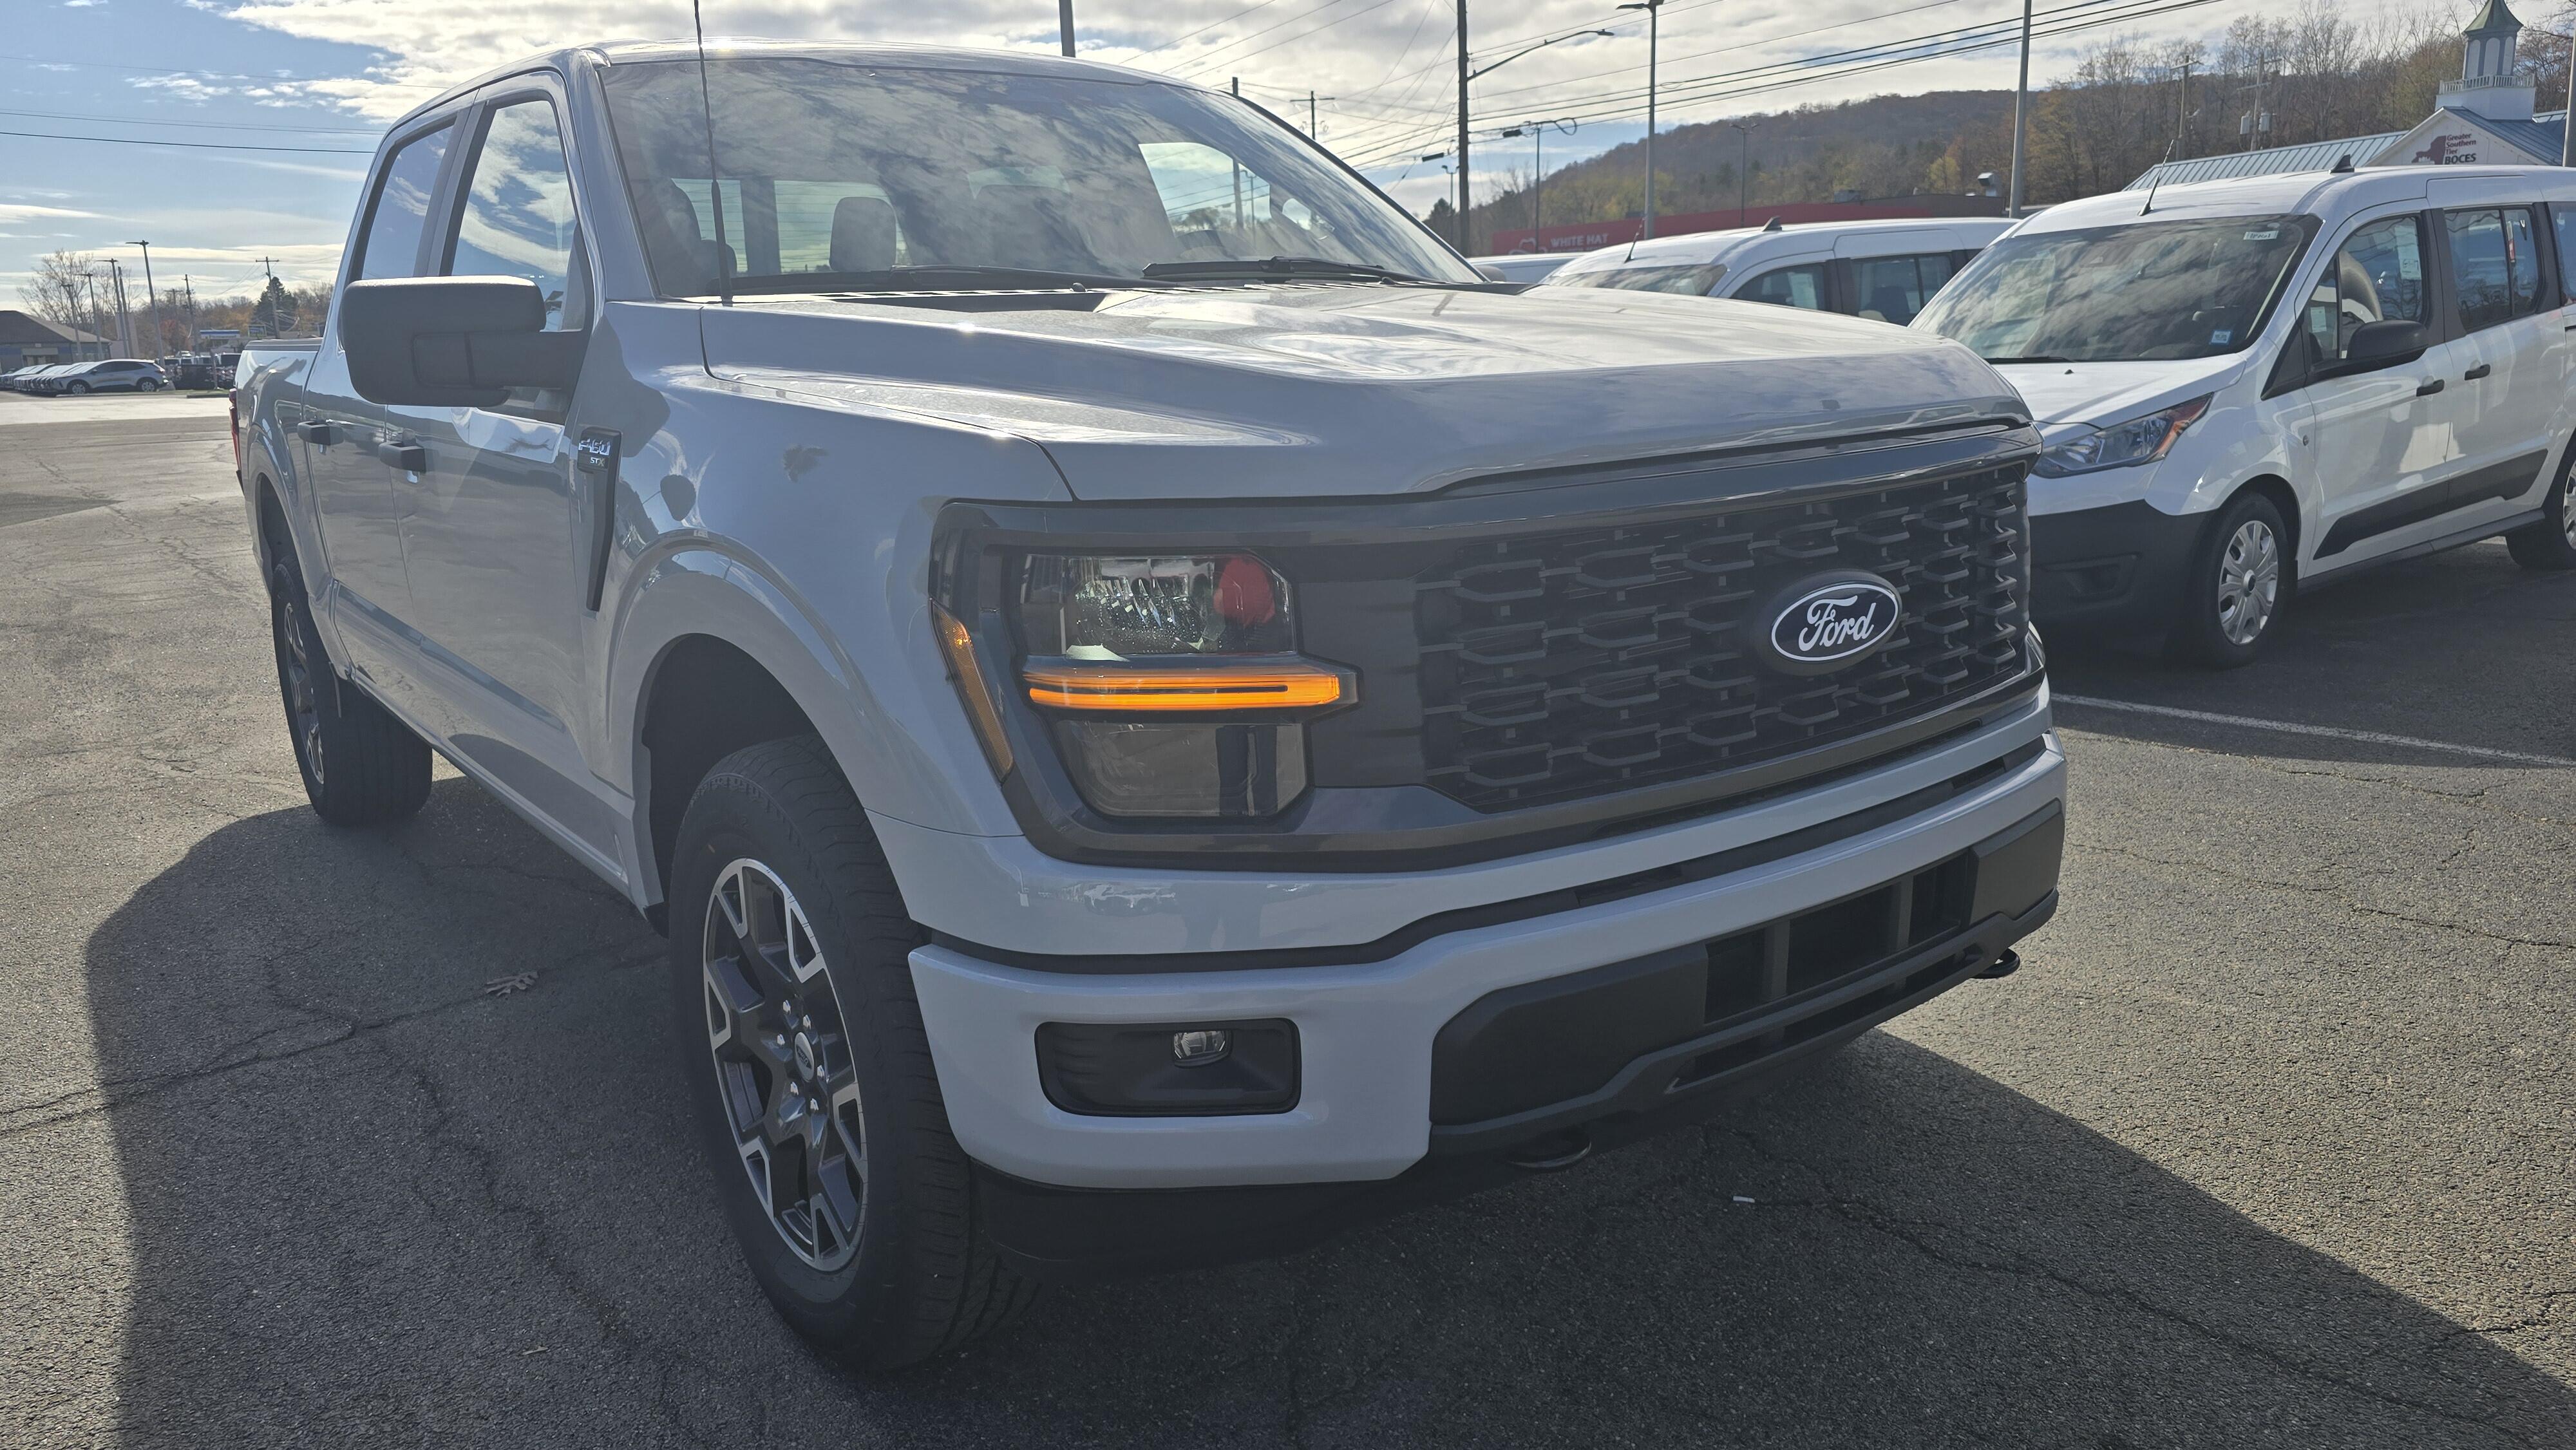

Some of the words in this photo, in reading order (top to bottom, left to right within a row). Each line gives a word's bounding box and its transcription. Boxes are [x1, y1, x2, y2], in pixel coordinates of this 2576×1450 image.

[2445, 153, 2476, 164] BOCES
[1550, 236, 1584, 247] WHITE
[1586, 234, 1608, 244] HAT
[591, 457, 605, 466] STX
[1798, 596, 1875, 651] Ford
